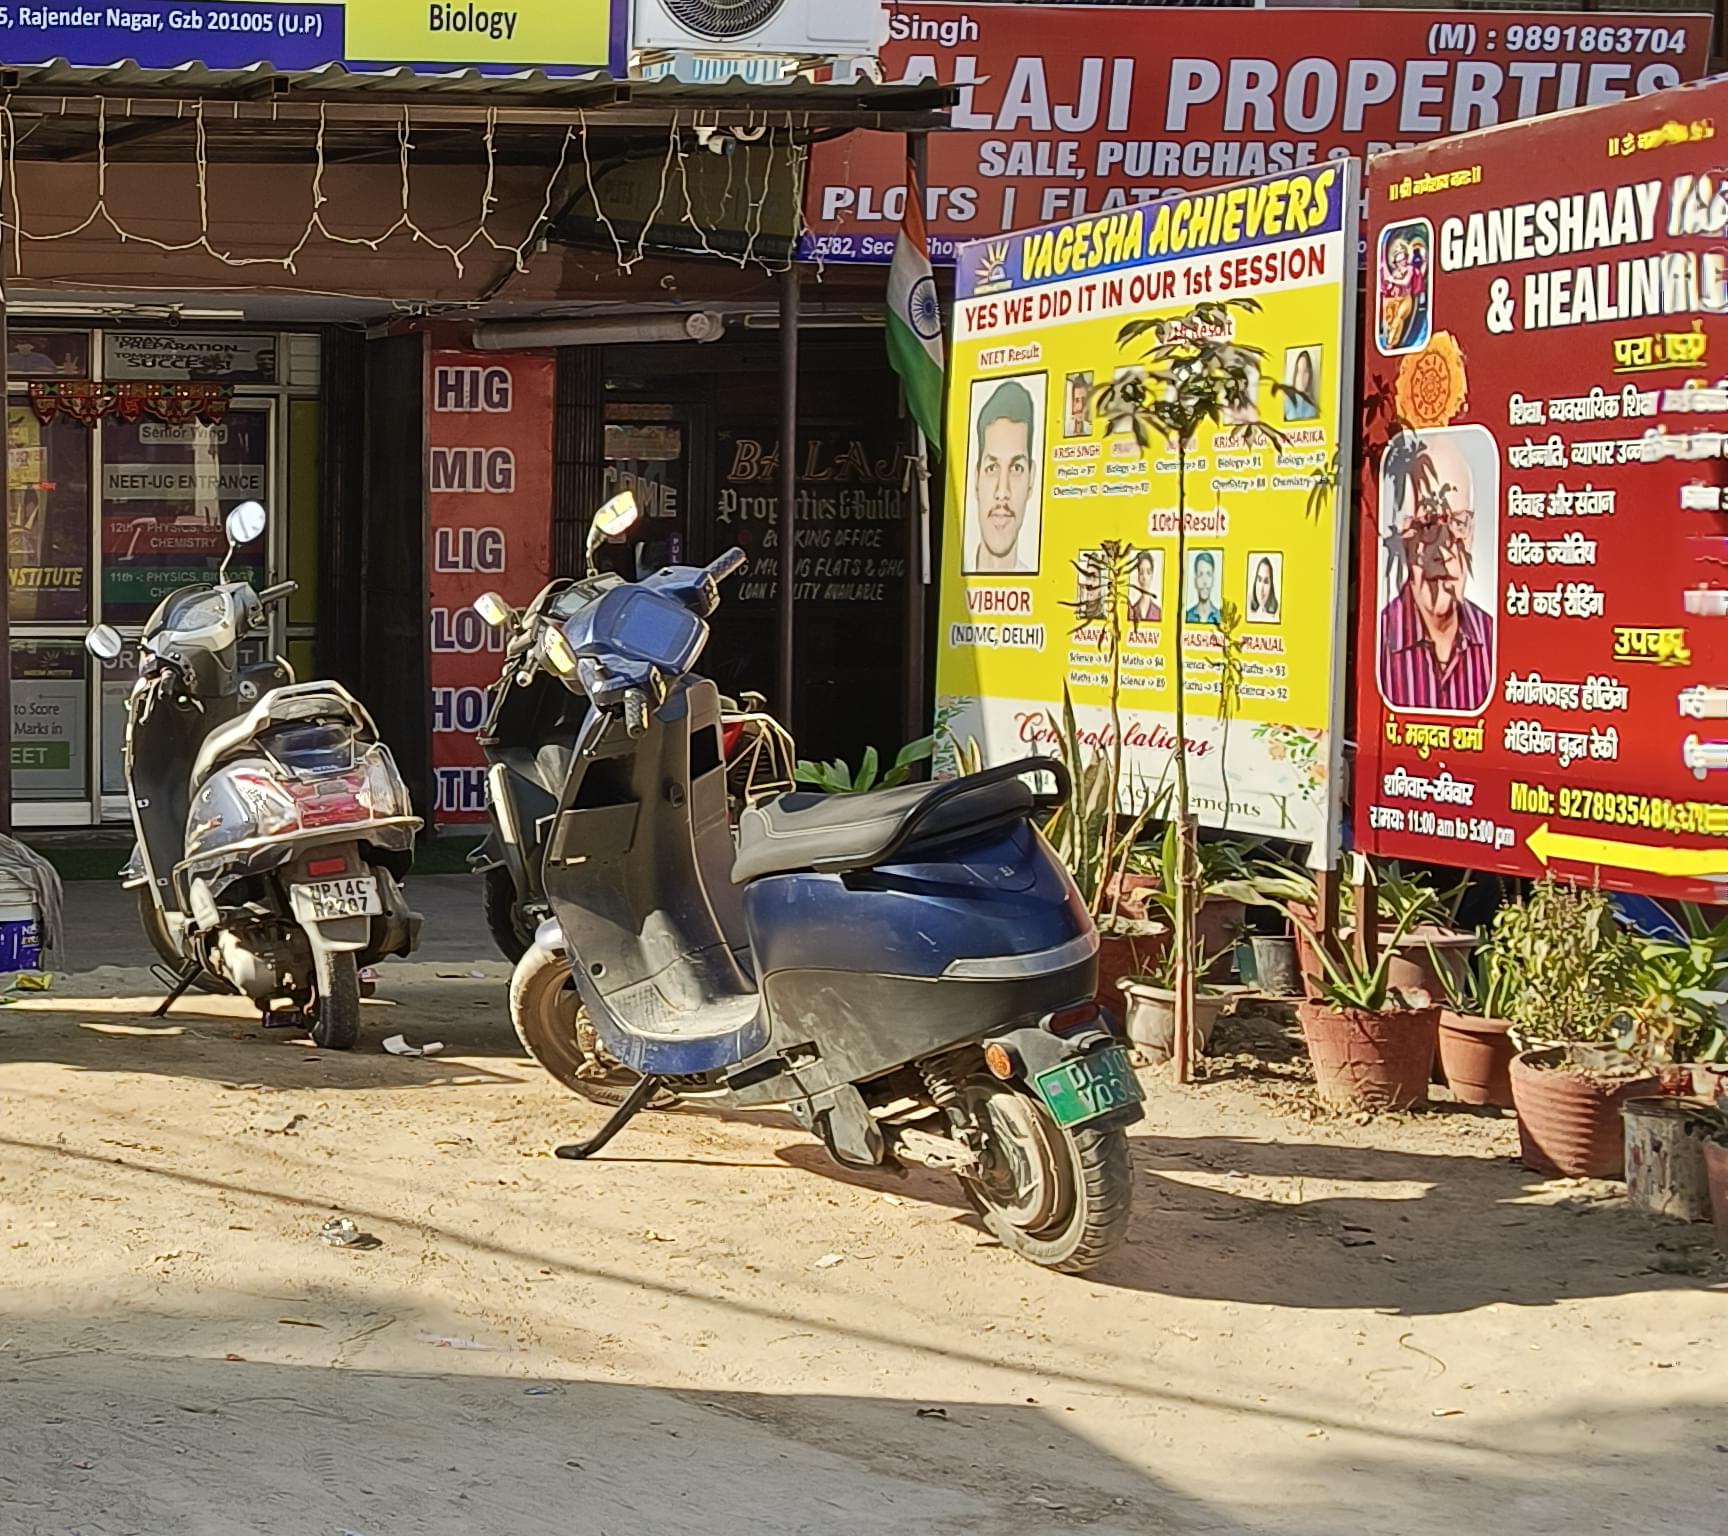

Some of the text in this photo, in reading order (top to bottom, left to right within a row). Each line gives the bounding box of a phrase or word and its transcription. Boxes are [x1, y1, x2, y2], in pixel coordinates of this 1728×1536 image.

[19, 7, 101, 33] Rajender
[105, 10, 164, 35] Nagar,
[169, 12, 202, 32] Gzb
[207, 13, 273, 33] 201005
[277, 13, 323, 38] (U.P)
[428, 3, 517, 39] Biology
[889, 13, 978, 46] Singh
[1428, 23, 1686, 55] (M) 9891863704
[979, 141, 1086, 180] SALE,
[1096, 140, 1319, 178] PURCHASE
[1021, 168, 1335, 282] VAGESHA ACHIEVERS
[1440, 180, 1663, 272] GANESHAAY
[965, 243, 1327, 333] YES WE DID IT IN OUR 1st SESSION
[1487, 277, 1515, 334] &
[434, 366, 513, 413] HIG
[142, 425, 186, 439] Senior
[109, 473, 259, 490] NEET-UG ENTRANCE
[431, 447, 515, 493] MIG
[1184, 510, 1226, 532] Result
[150, 536, 218, 550] CHEMISTRY
[434, 526, 506, 574] LIG
[834, 528, 883, 547] OFFICE
[7, 566, 83, 587] NSTITUTE
[824, 583, 885, 601] AVAILABLE
[967, 591, 1031, 613] VIBHOR
[951, 625, 1044, 648] (NDMC, DELHI)
[14, 702, 60, 715] to Score
[14, 721, 63, 735] Marks in
[1014, 712, 1215, 758] Conratlations
[1510, 781, 1555, 817] Mob:
